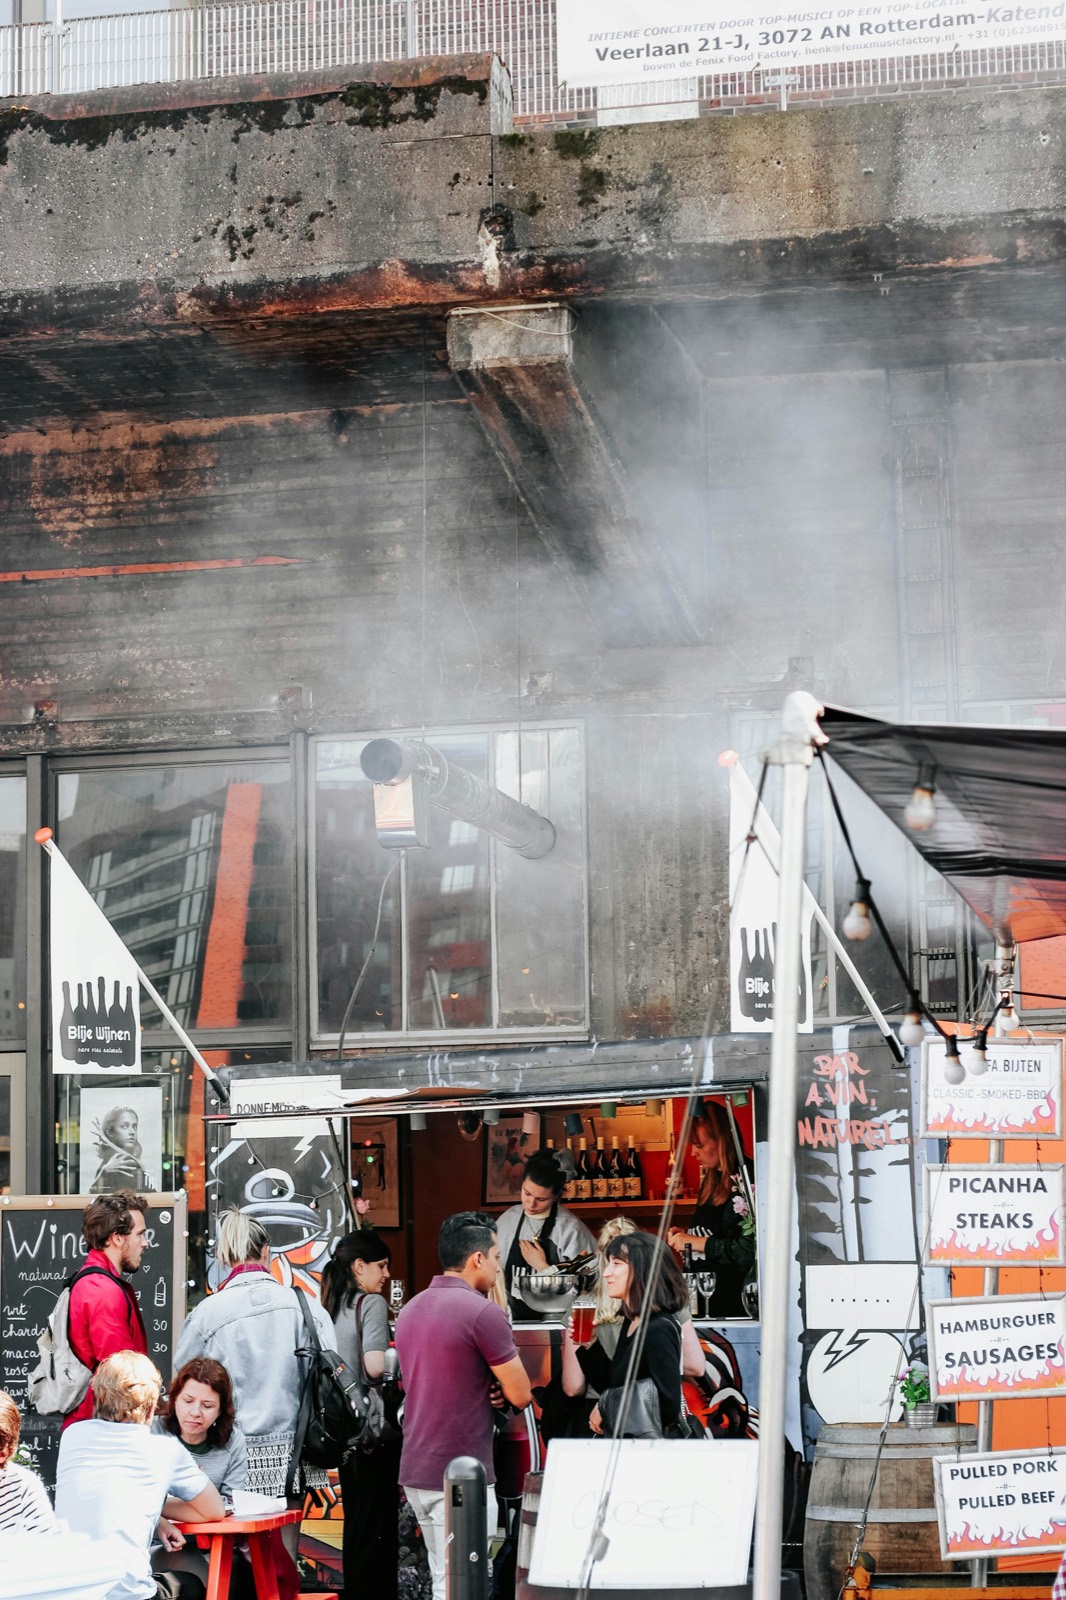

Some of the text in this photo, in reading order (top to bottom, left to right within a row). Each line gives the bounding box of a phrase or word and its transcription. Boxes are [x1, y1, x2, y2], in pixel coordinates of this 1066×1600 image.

[588, 30, 640, 42] INTIEME
[643, 22, 716, 37] CONCERTEN
[719, 18, 754, 30] DOOR
[758, 11, 835, 26] TOP-MUSICI
[837, 9, 856, 19] OP
[858, 7, 882, 17] EEN
[595, 41, 690, 62] Veerlaan
[698, 34, 750, 52] 21-J,
[758, 28, 813, 47] 3072
[820, 24, 851, 40] AN
[643, 62, 677, 72] boven
[679, 60, 693, 68] de
[696, 56, 725, 67] Fenix
[728, 53, 754, 63] Food
[805, 32, 955, 55] henk@fenixmusicfactory.nl
[967, 30, 989, 39] +31
[745, 977, 770, 998] Blije
[67, 1025, 131, 1044] Blije Wijnen
[812, 1051, 871, 1080] BAR
[805, 1082, 824, 1107] A
[933, 1088, 974, 1099] CLASSIC
[949, 1177, 1048, 1193] PICANHA
[956, 1213, 1034, 1229] STEAKS
[7, 1219, 89, 1260] Wine
[18, 1267, 68, 1281] natural
[153, 1320, 168, 1331] 30
[940, 1312, 1056, 1335] HAMBURGUER
[152, 1343, 168, 1353] 30
[944, 1342, 1058, 1368] SAUSAGES
[3, 1362, 30, 1376] rosé
[950, 1460, 1058, 1480] PULLED PORK
[958, 1490, 1056, 1510] PULLED BEEF
